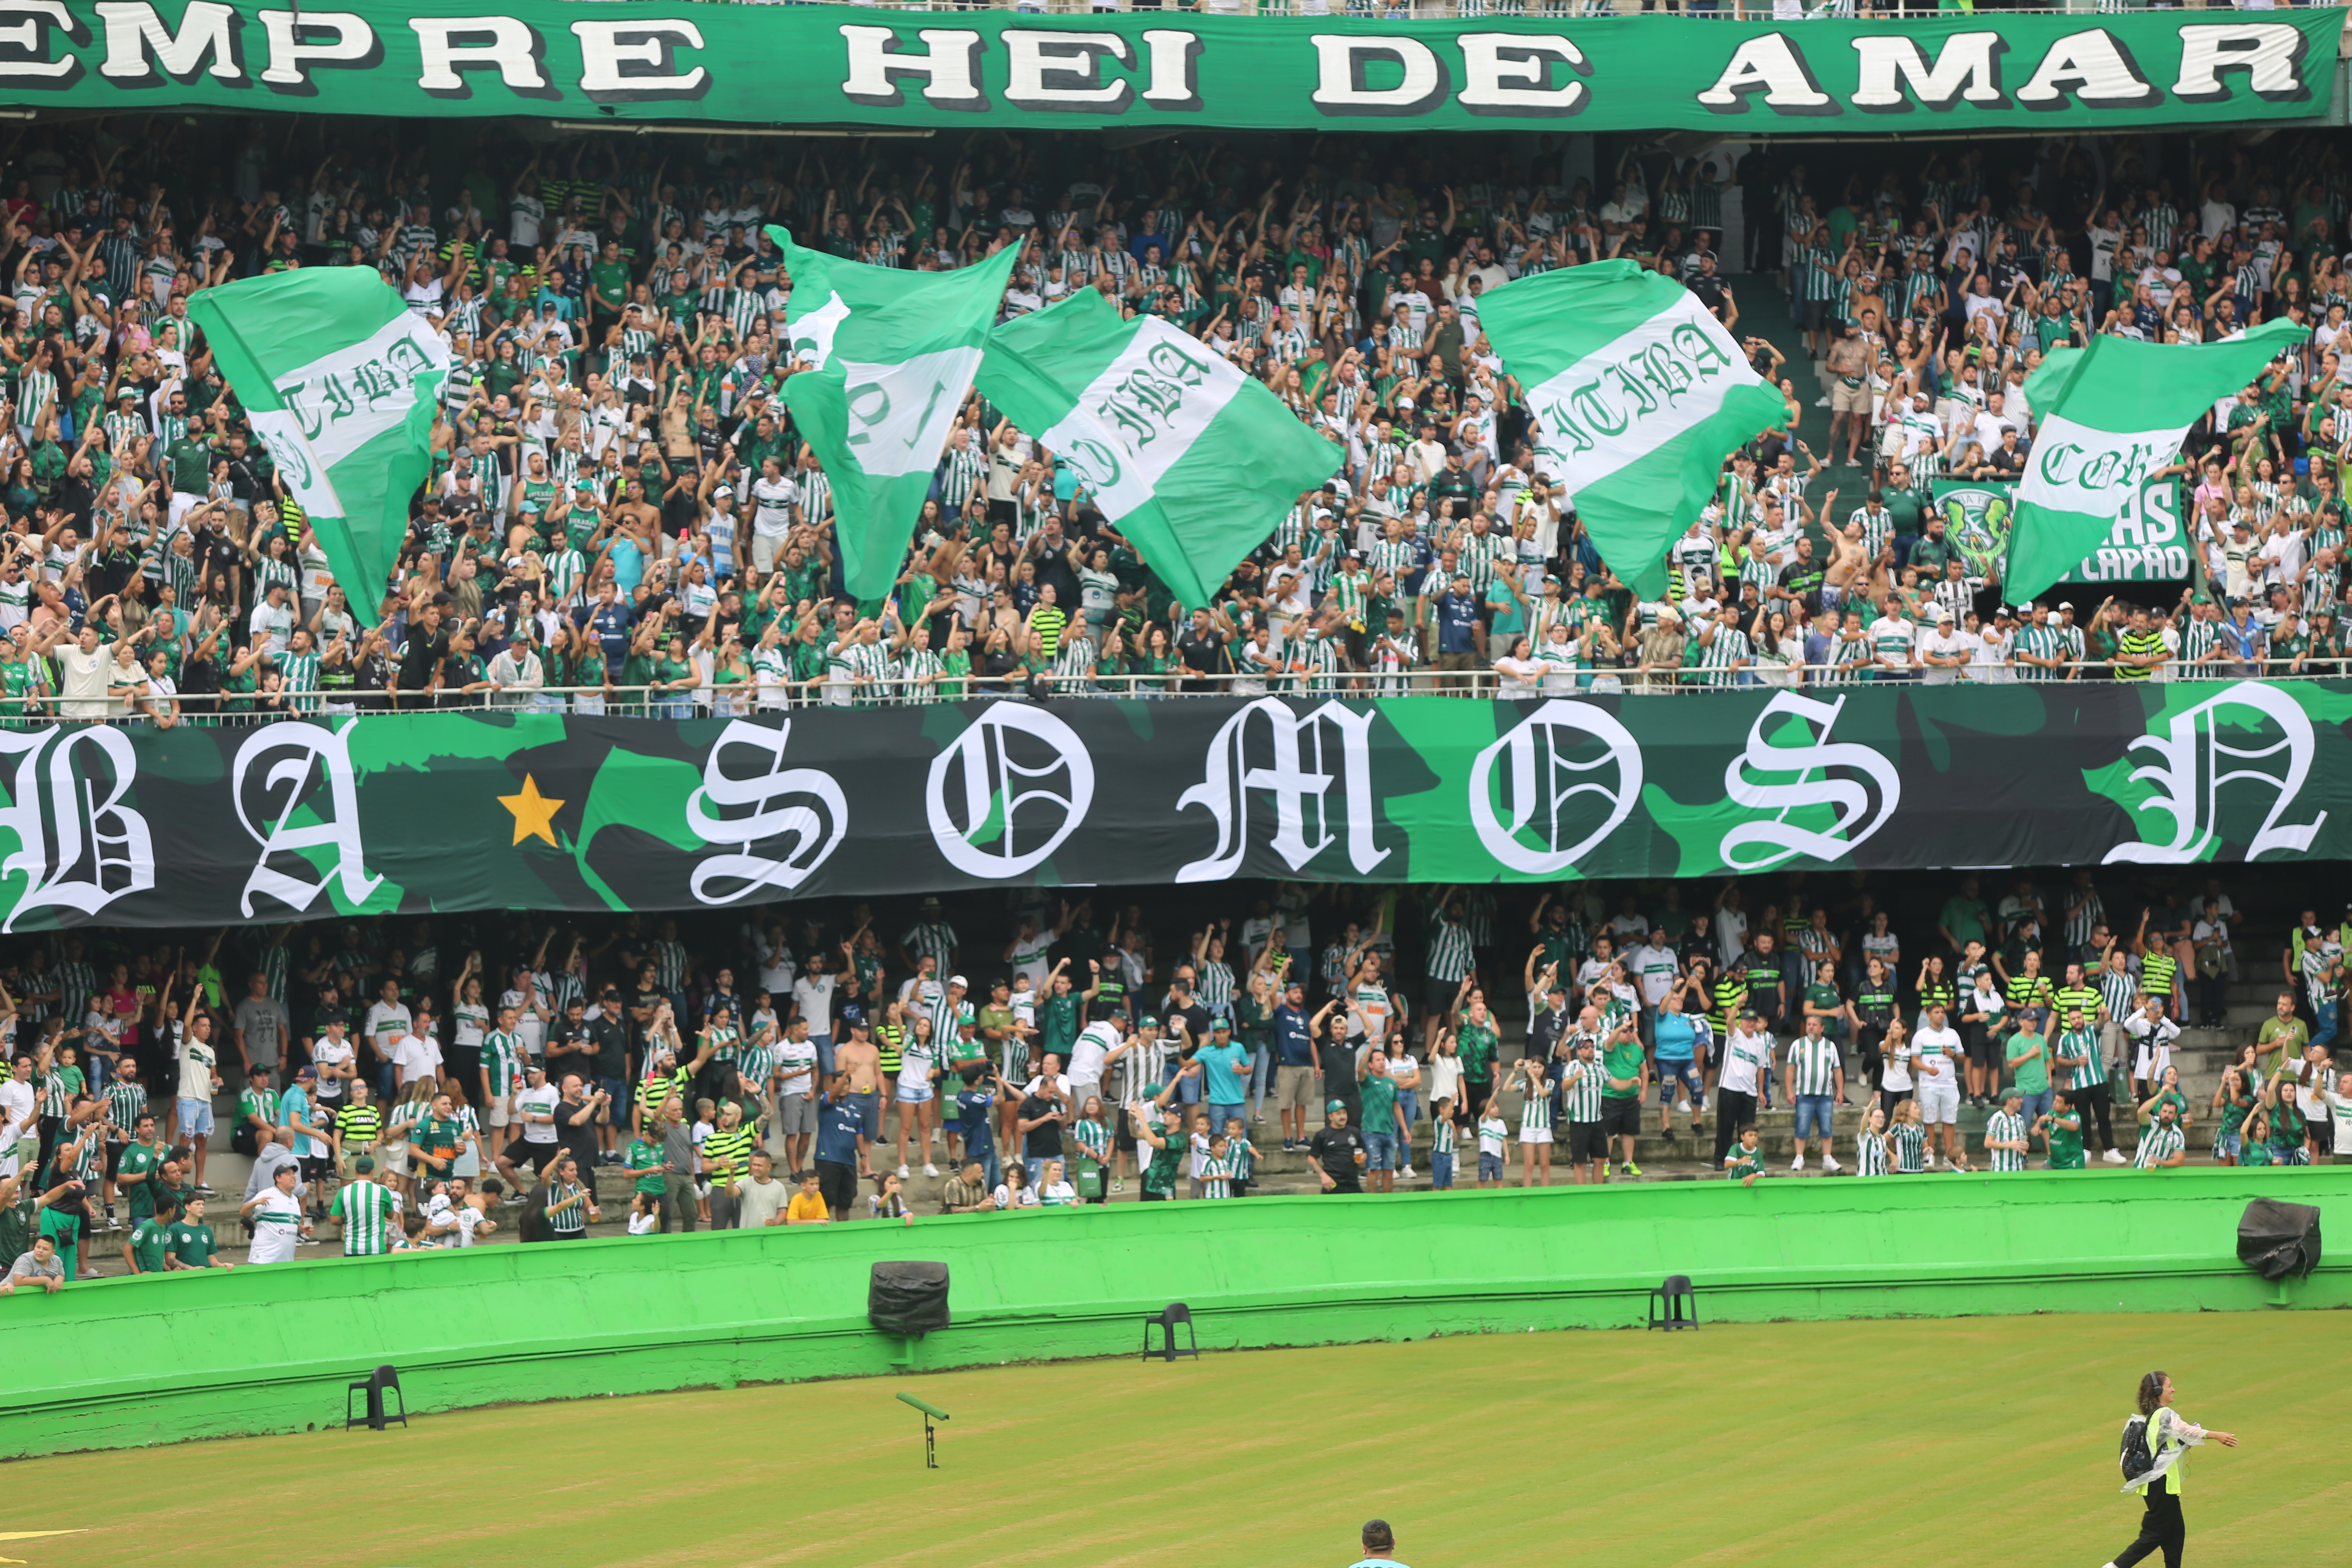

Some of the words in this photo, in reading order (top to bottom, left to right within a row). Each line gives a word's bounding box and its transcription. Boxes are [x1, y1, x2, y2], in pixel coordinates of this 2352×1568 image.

[838, 24, 1205, 103] HEI
[1307, 31, 1586, 107] DE
[1695, 22, 2305, 108] AMAR
[685, 689, 1902, 906] SOMOS
